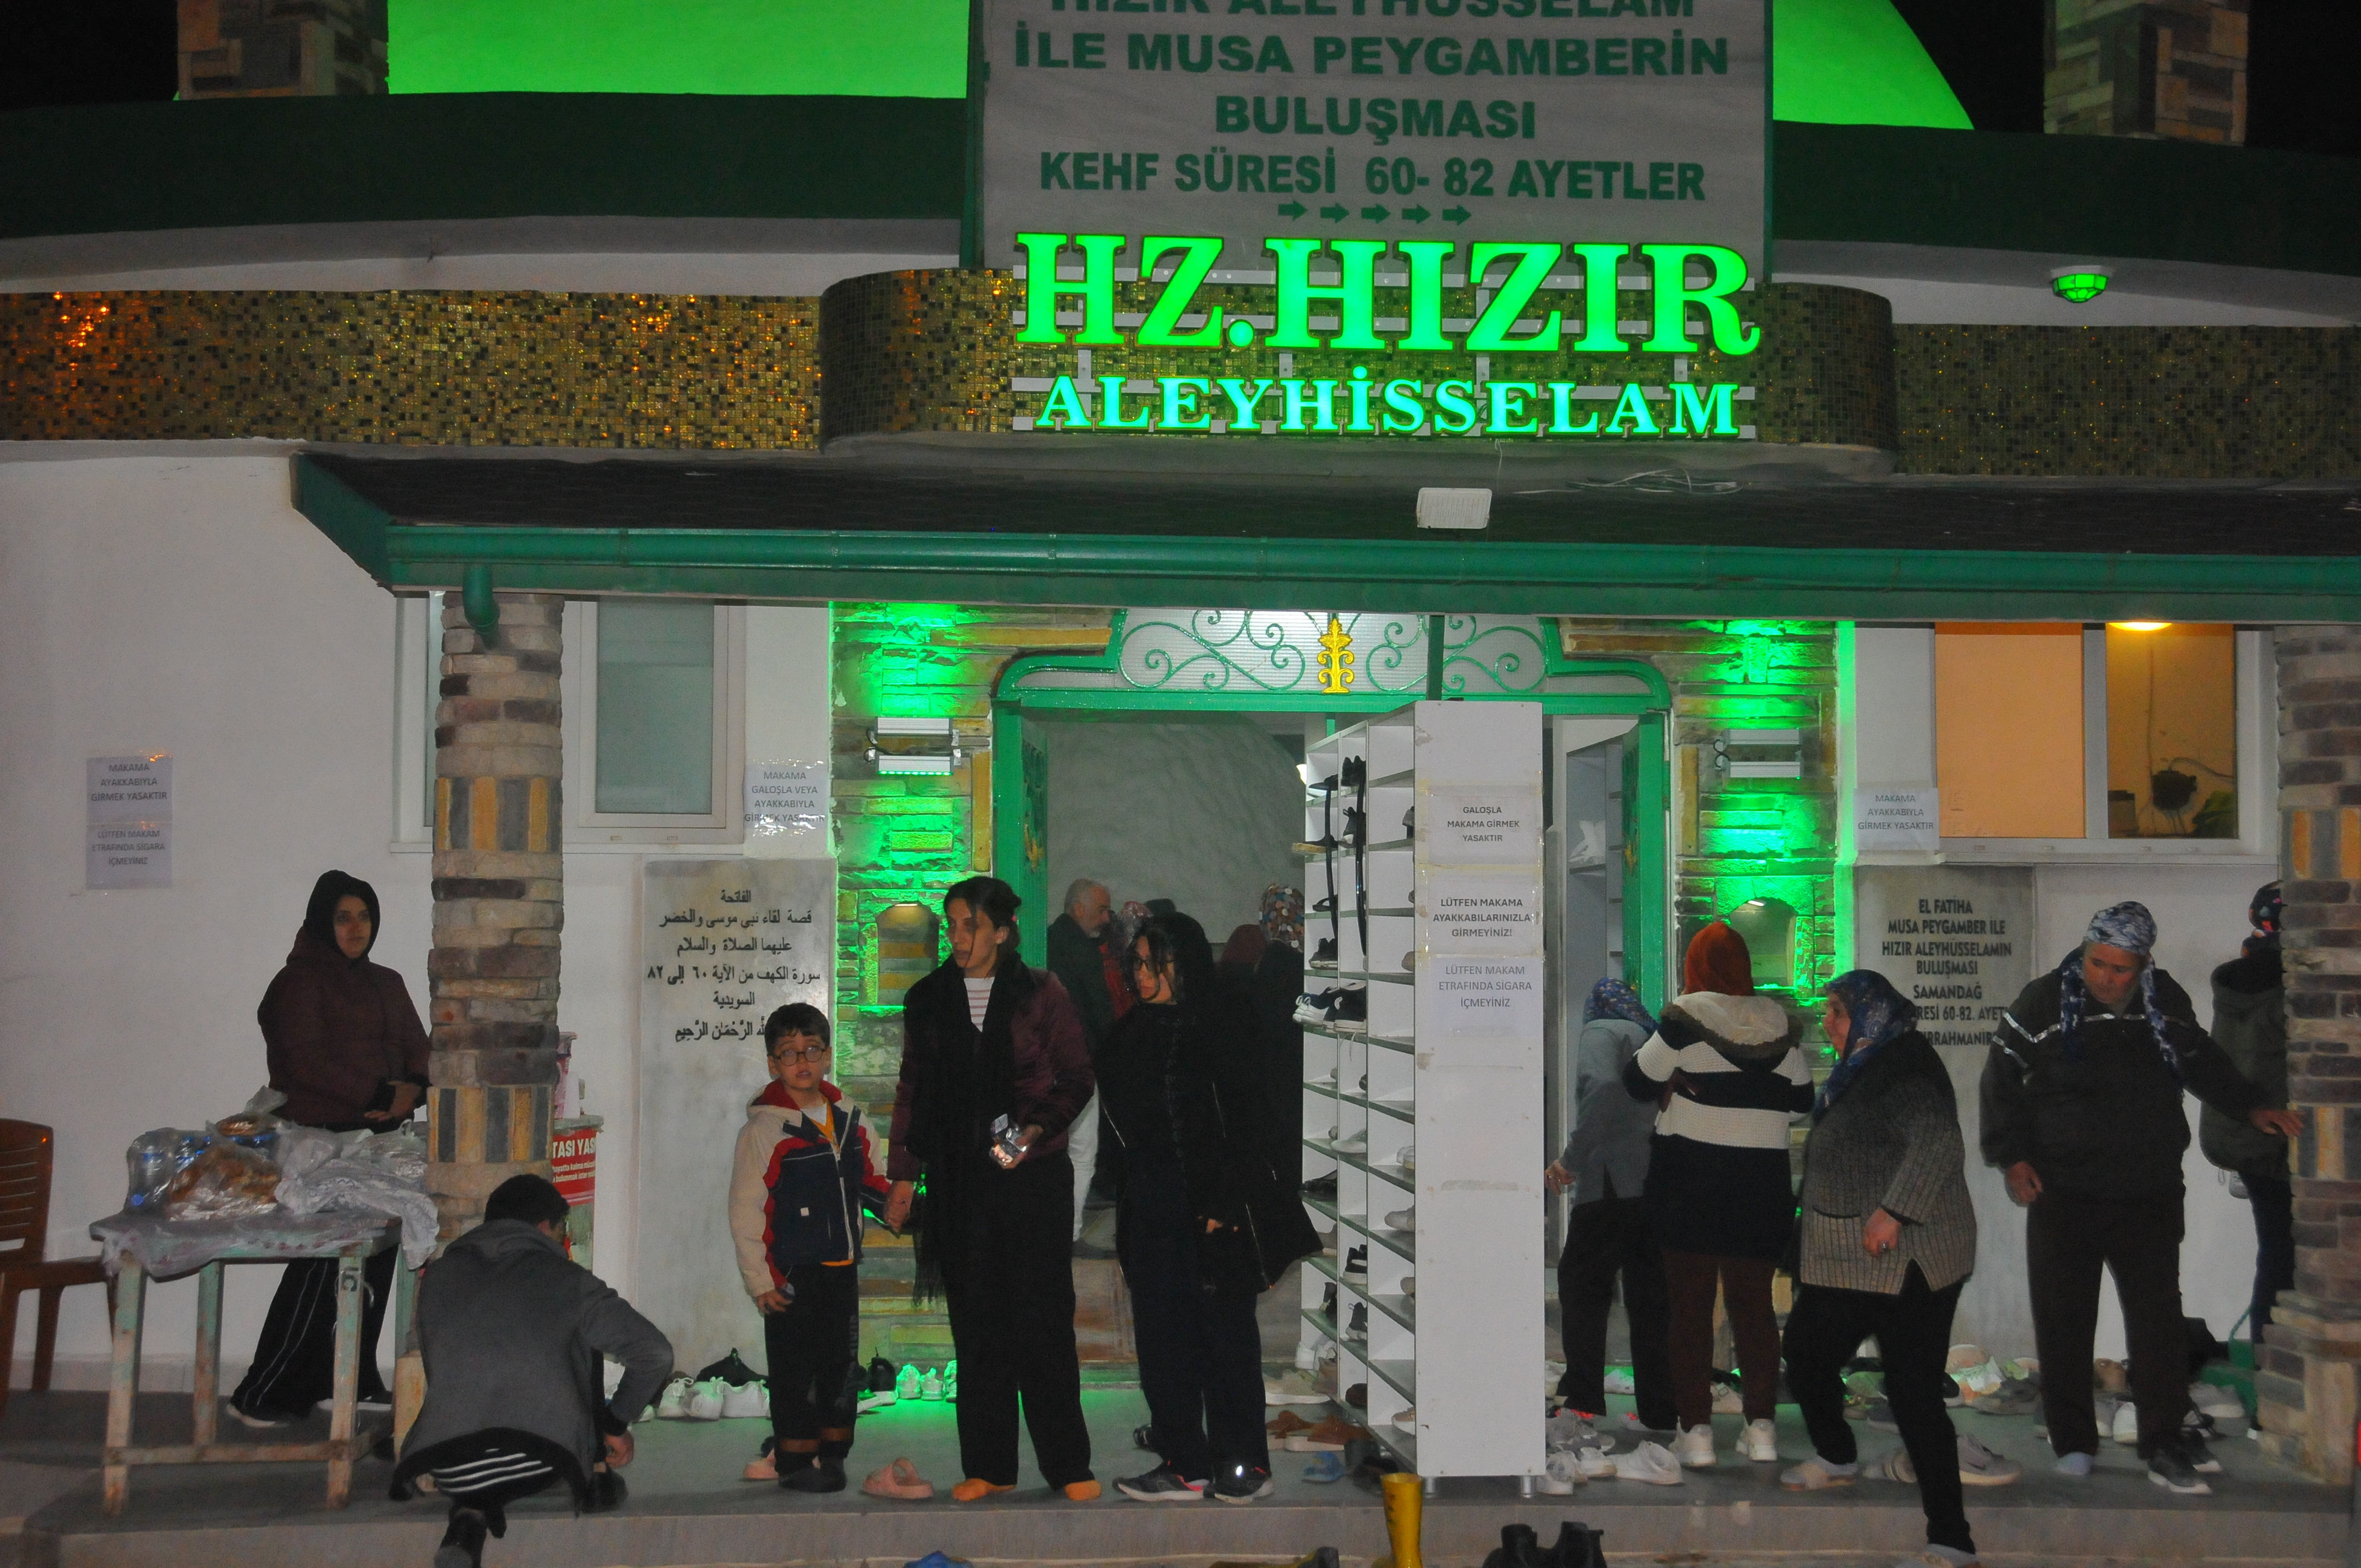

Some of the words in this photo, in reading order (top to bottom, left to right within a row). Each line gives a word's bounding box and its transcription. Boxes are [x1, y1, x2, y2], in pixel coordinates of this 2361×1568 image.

[1015, 20, 1106, 69] İLE
[1127, 34, 1294, 73] MUSA
[1314, 29, 1728, 75] PEYGAMBERİN
[1215, 95, 1535, 145] BULUŞMASI
[1041, 151, 1158, 191] KEHF
[1174, 146, 1335, 194] SÜRESİ
[1443, 159, 1494, 198] 82
[1508, 160, 1705, 201] AYETLER
[1036, 366, 1739, 437] ALEYHİSSELAM
[110, 764, 150, 772] MAKAMA
[101, 777, 157, 787] AYAKKABIYLA
[91, 792, 124, 802] GİRMEK
[127, 791, 167, 800] YASAKTIR
[752, 786, 792, 795] GALOŞLA
[1463, 806, 1502, 815] GALOŞLA
[1487, 819, 1520, 827] GİRMEK
[1858, 820, 1891, 830] GİRMEK
[98, 829, 126, 839] LÜTFEN
[128, 830, 160, 838] MAKAM
[92, 843, 134, 852] ETRAFINDA
[136, 842, 165, 851] SİGARA
[721, 890, 752, 903] الفاتحة
[1441, 898, 1477, 907] LÜTFEN
[1919, 899, 1931, 913] EL
[1934, 895, 1973, 914] FATİHA
[762, 909, 781, 923] لقاء
[787, 910, 812, 923] قصة
[1433, 914, 1531, 922] AYAKKABILARINIZLA
[1452, 927, 1512, 937] GİRMEYİNİZ!
[1888, 920, 1919, 934] MUSA
[1922, 920, 1987, 934] PEYGAMBER
[1990, 917, 2006, 934] İLE
[677, 936, 716, 956] والسلام
[722, 937, 757, 951] الصلاة
[761, 937, 792, 955] عليهما
[1882, 941, 1912, 956] HIZIR
[757, 966, 788, 983] الكهف
[792, 968, 820, 984] سورة
[1446, 965, 1482, 974] LÜTFEN
[1486, 966, 1525, 974] MAKAM
[1916, 961, 1978, 979] BULUŞMASI
[738, 970, 753, 984] من
[1439, 982, 1493, 990] ETRAFINDA
[1495, 980, 1532, 990] SİGARA
[1913, 982, 1982, 999] SAMANDAĞ
[1460, 997, 1510, 1009] İÇMEYİNİZ
[1916, 1004, 1939, 1020] RESİ
[1979, 1006, 2009, 1020] AYET
